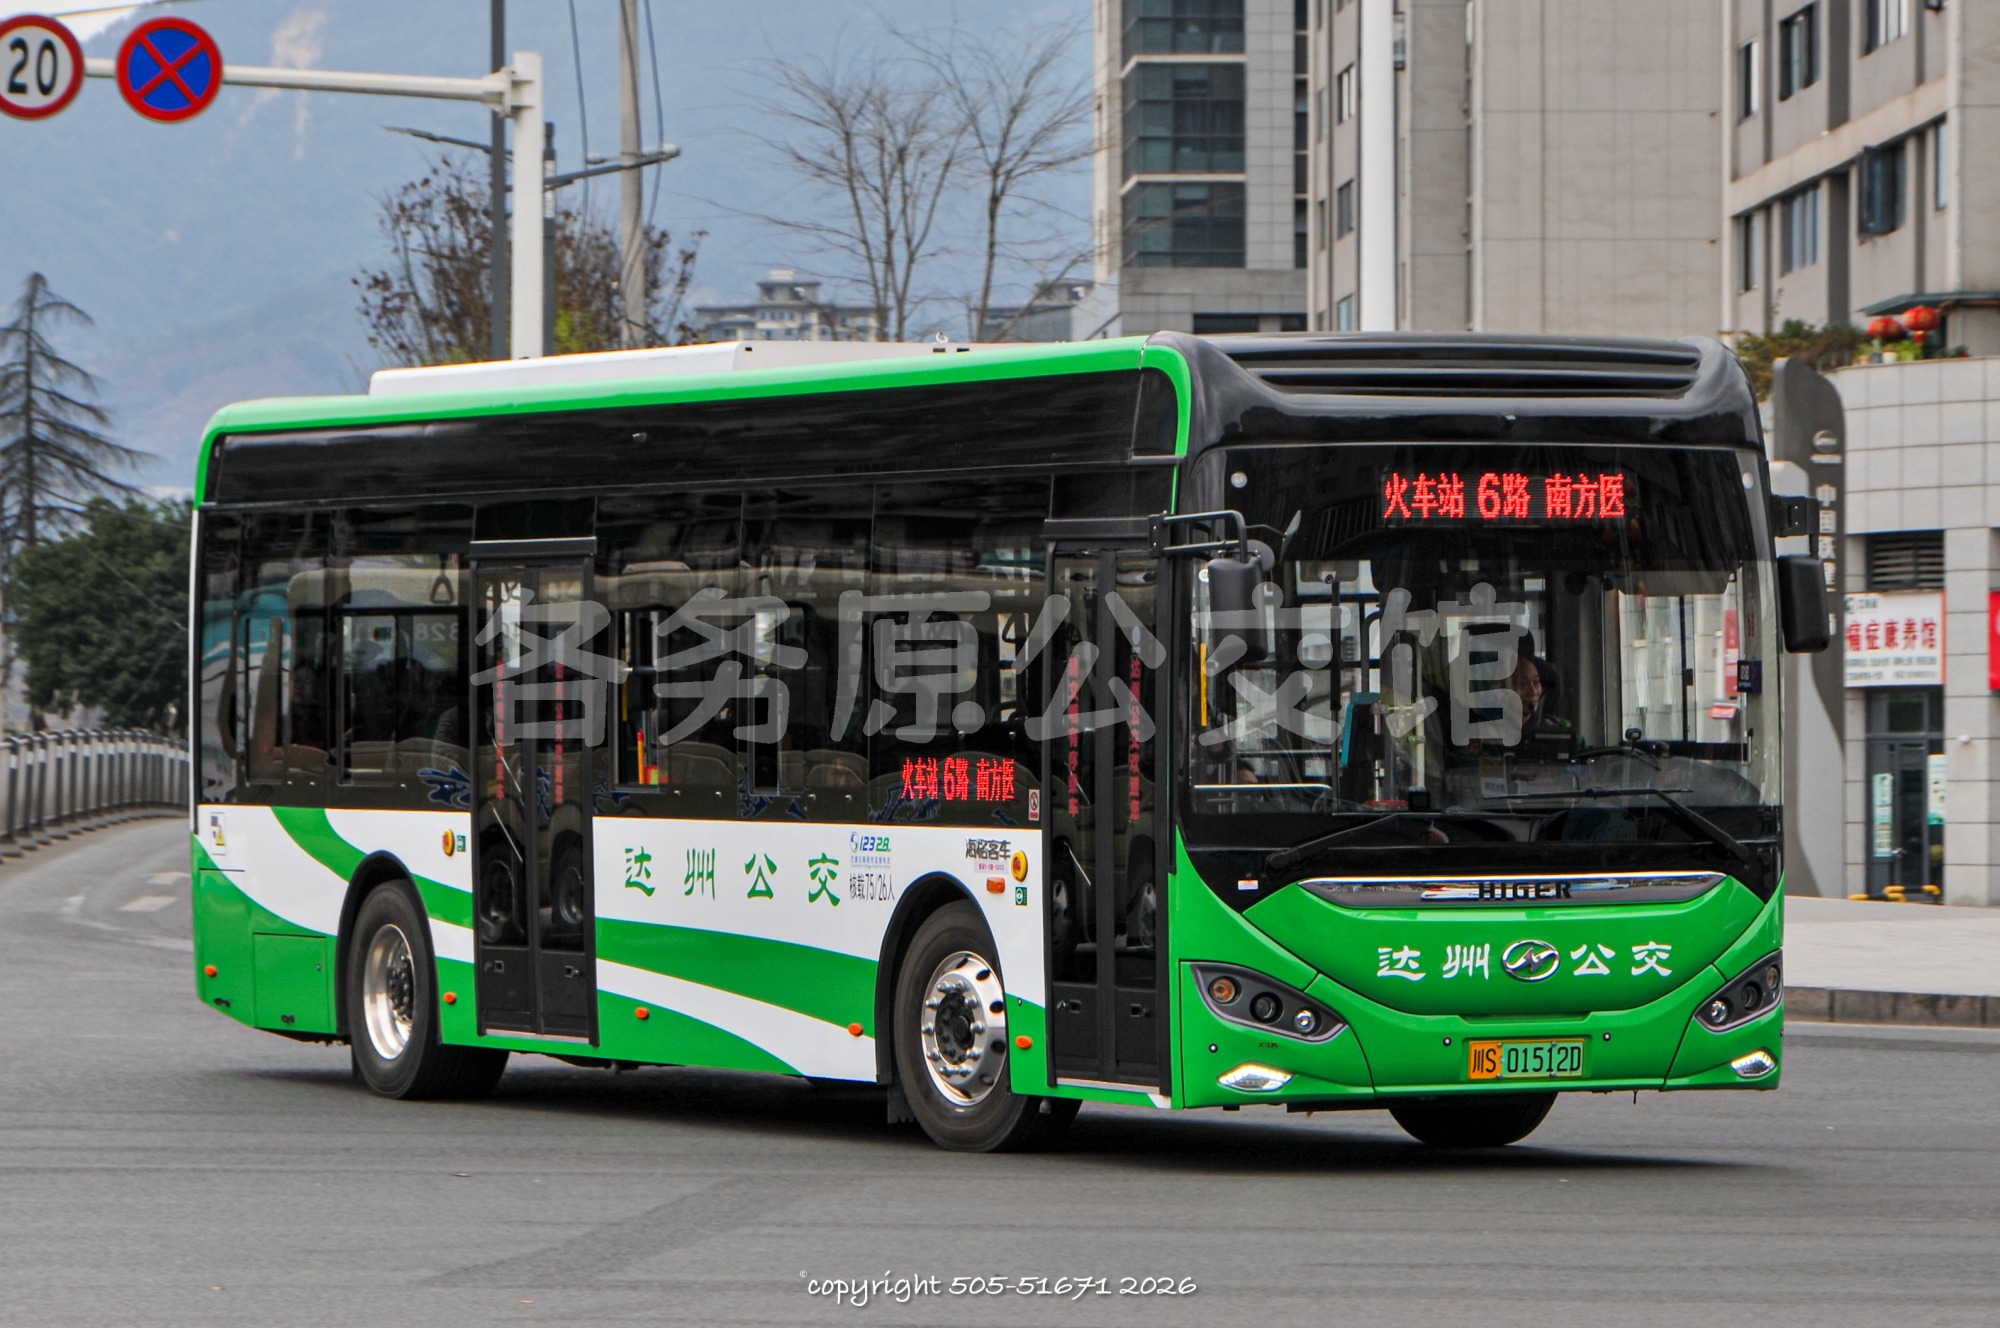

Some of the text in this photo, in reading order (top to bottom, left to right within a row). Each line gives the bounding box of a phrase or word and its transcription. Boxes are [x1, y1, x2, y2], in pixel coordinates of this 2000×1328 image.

[8, 37, 58, 96] 20
[1384, 472, 1625, 519] 火车站 6路 南方医
[900, 756, 1016, 802] 火车站 6路 南方医
[965, 837, 1012, 860] 海格客车
[624, 845, 841, 907] 达州公交
[1478, 881, 1572, 900] HIGER
[1376, 940, 1673, 981] 达州 公交
[1472, 1045, 1582, 1074] 川S 01512D
